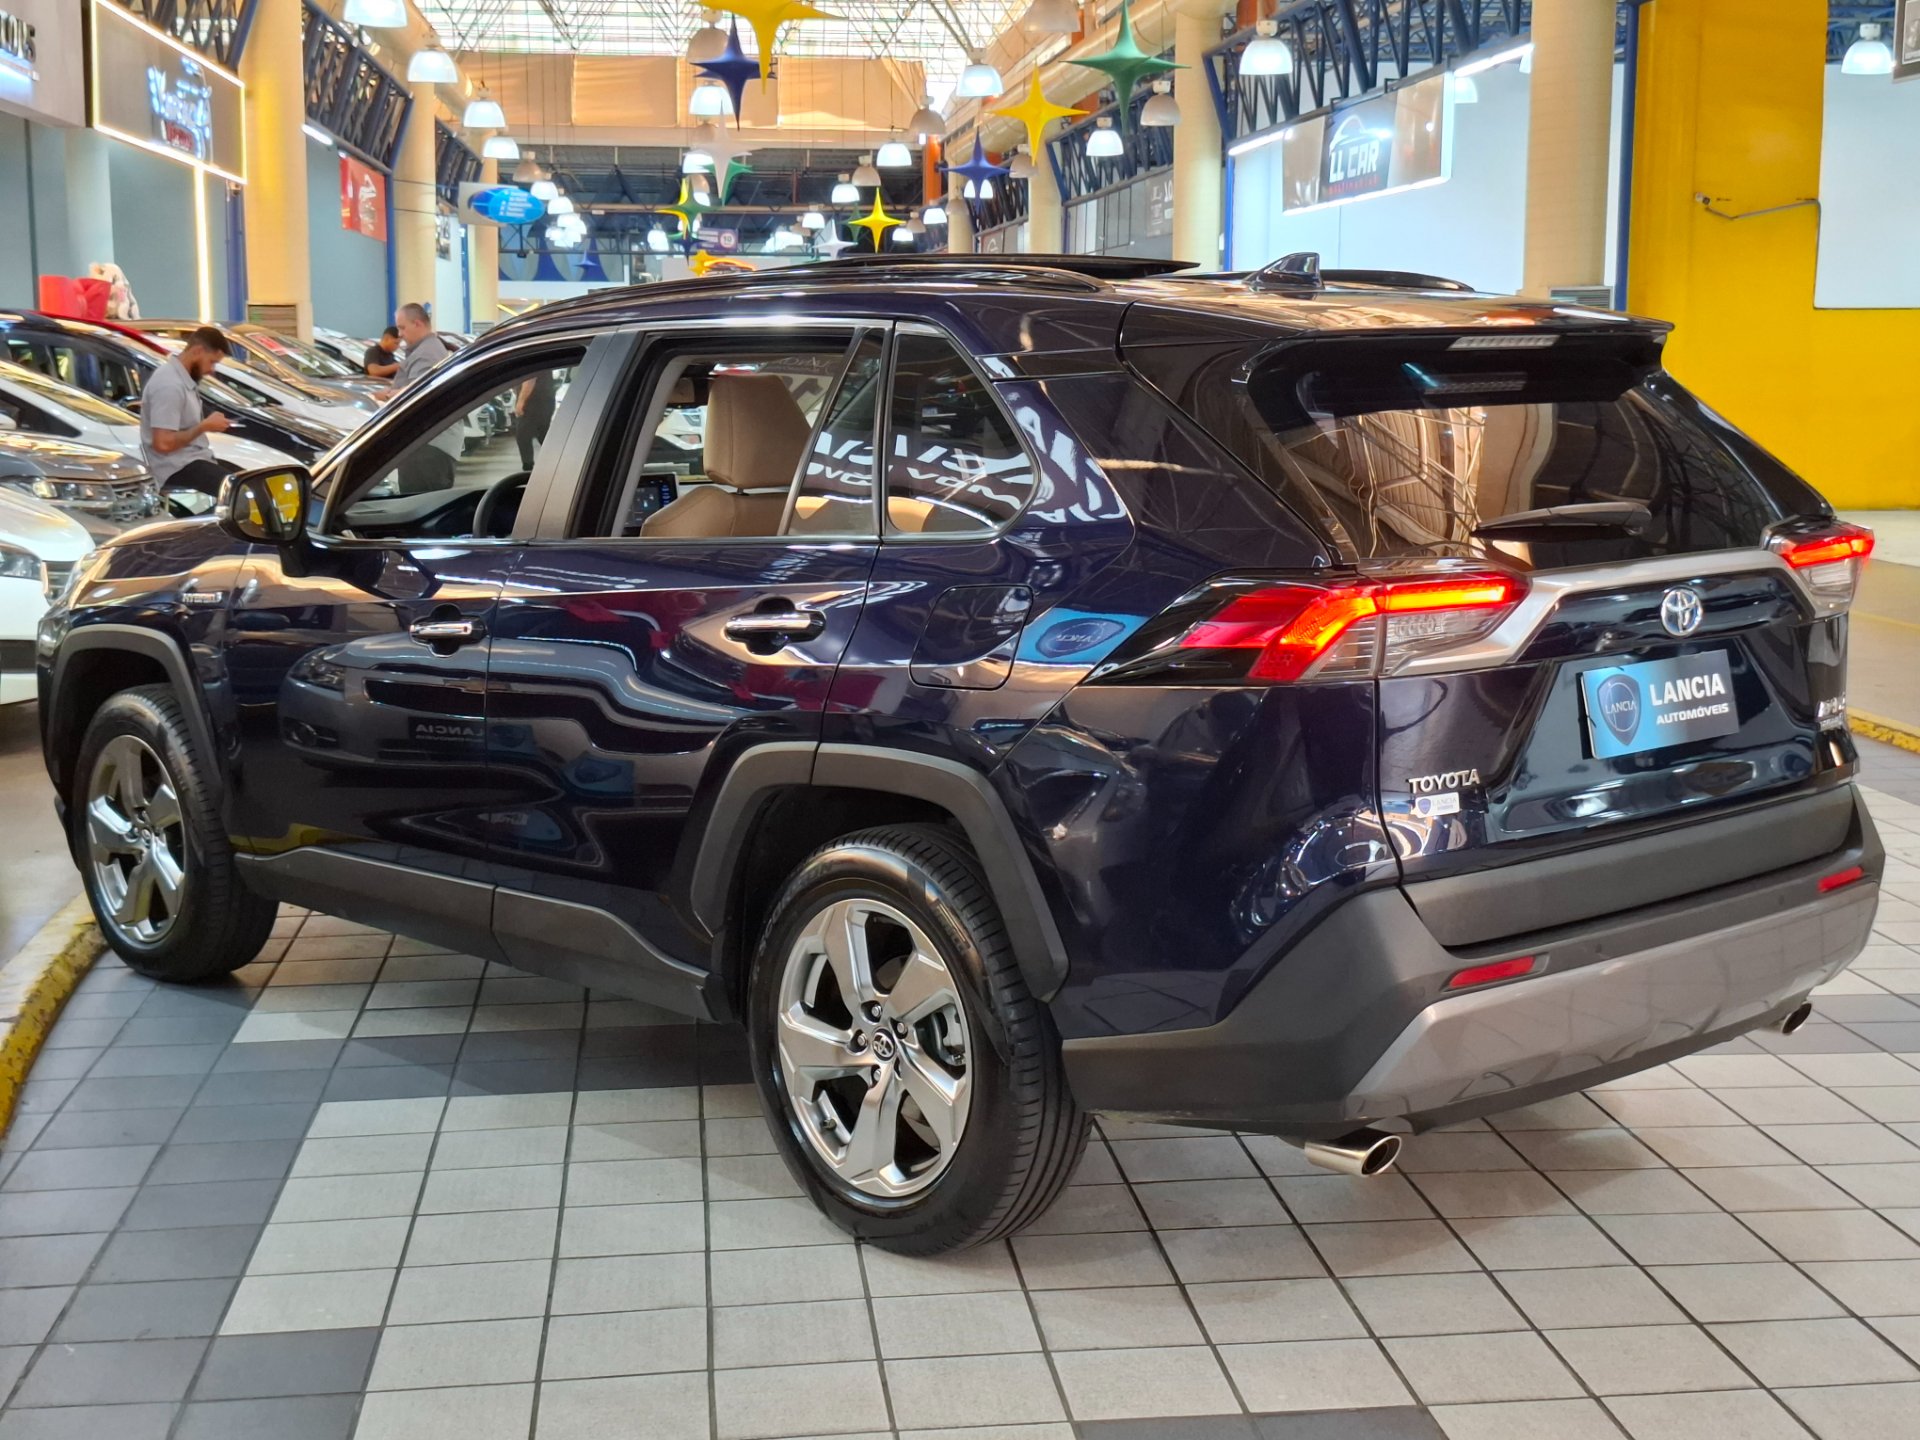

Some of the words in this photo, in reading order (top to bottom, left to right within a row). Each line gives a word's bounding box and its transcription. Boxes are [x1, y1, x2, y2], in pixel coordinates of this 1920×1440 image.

[1347, 139, 1380, 179] CAR
[1649, 673, 1726, 706] LANCIA
[1604, 700, 1638, 715] LANCIA
[1656, 702, 1730, 725] AUTOMÓVEIS
[1408, 768, 1480, 794] TOYOTA
